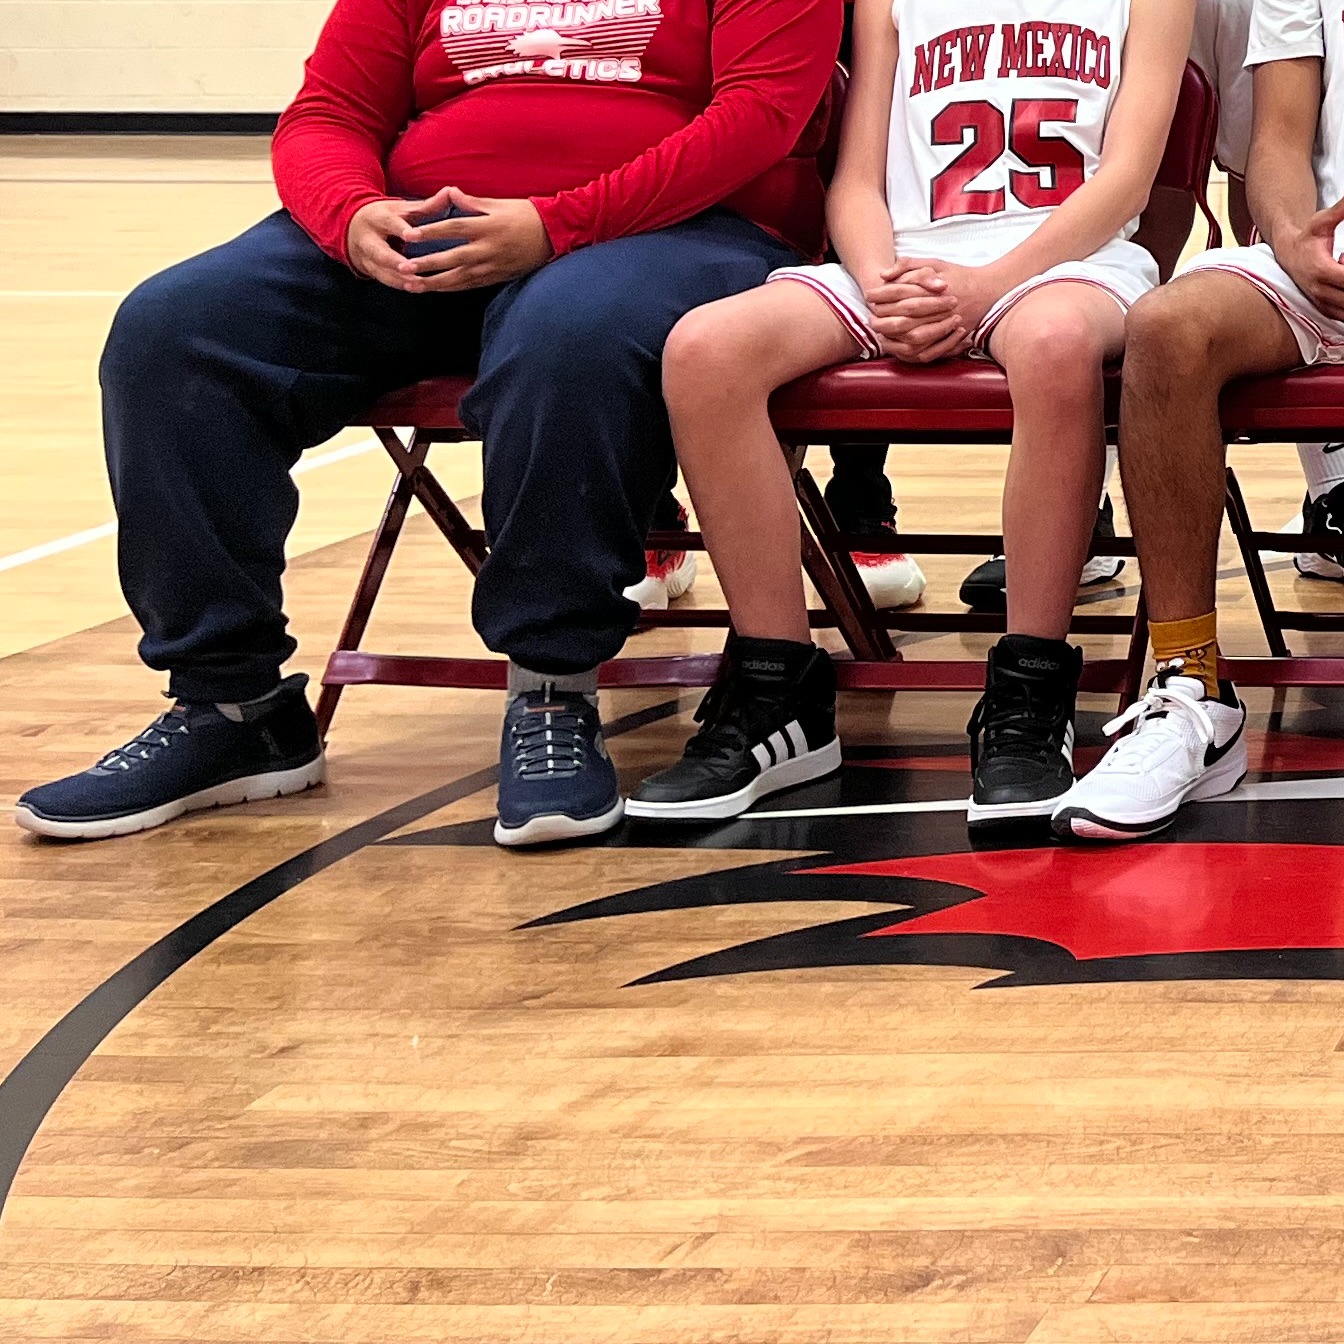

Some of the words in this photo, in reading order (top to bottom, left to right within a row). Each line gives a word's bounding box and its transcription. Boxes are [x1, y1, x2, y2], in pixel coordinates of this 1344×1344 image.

[909, 24, 995, 98] NEW
[997, 21, 1110, 89] MEXICO
[930, 98, 1086, 222] 25
[1018, 657, 1060, 670] adida
